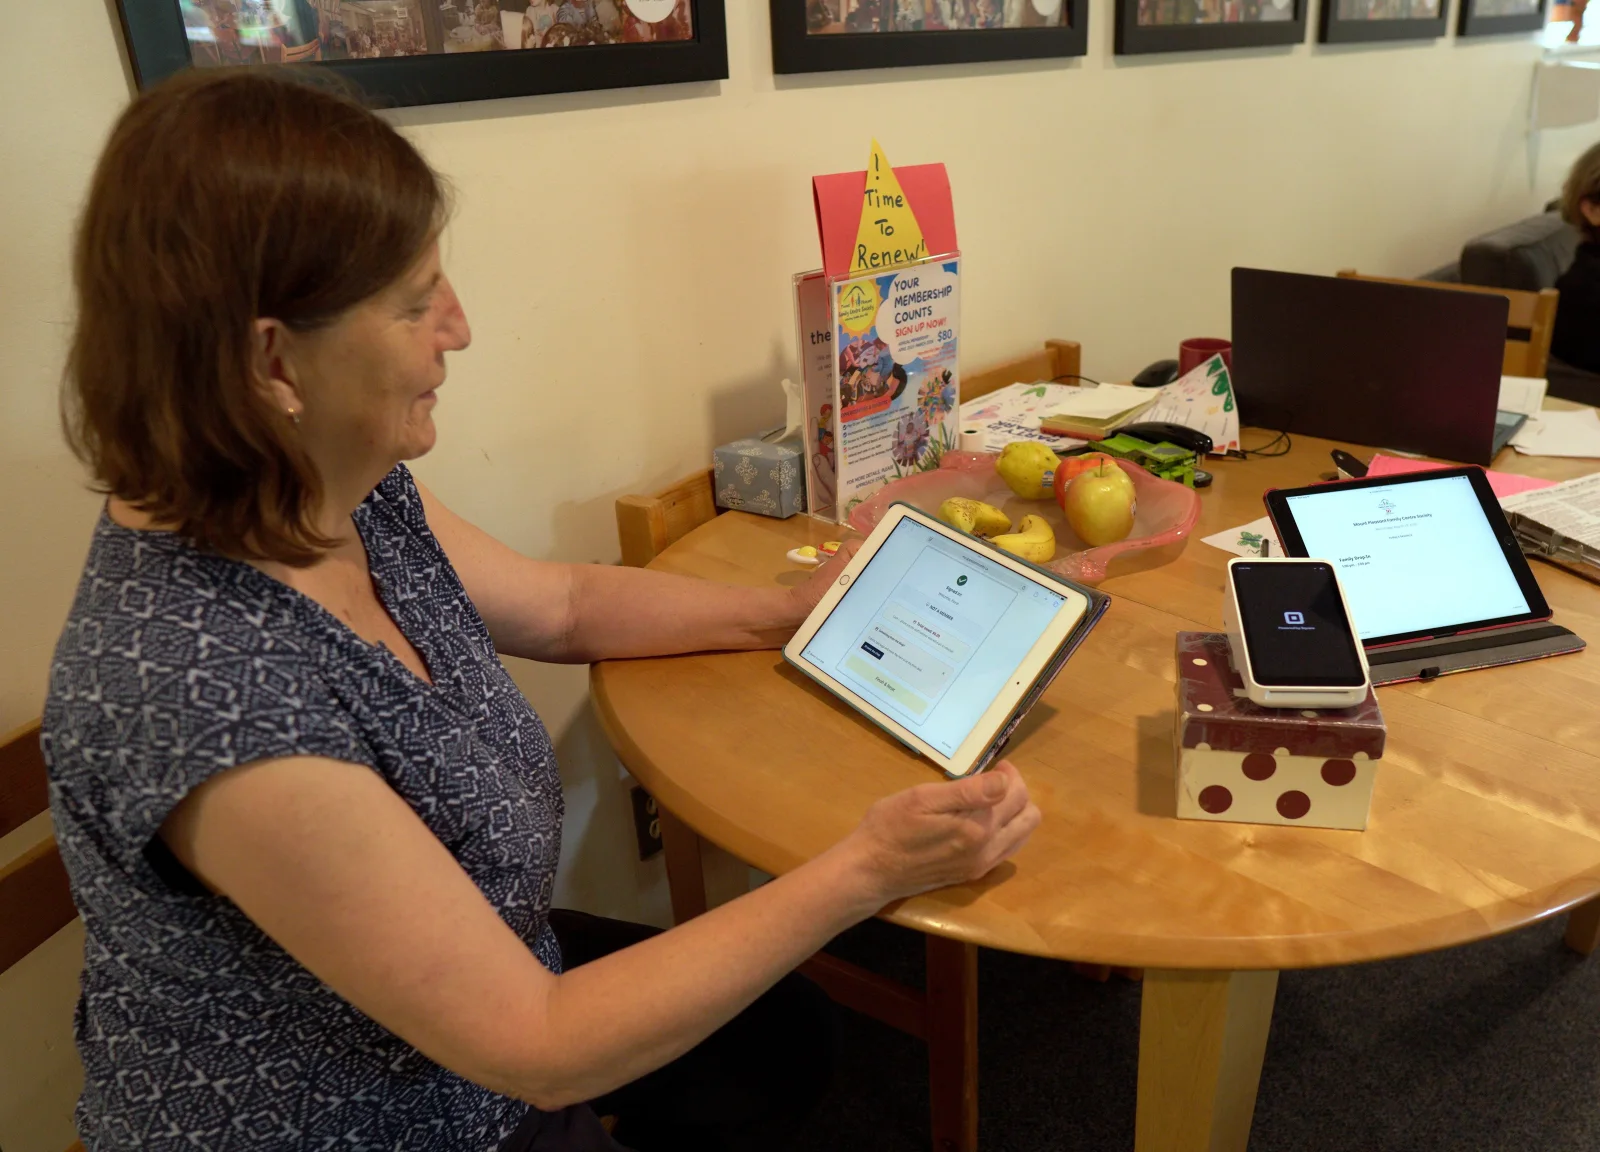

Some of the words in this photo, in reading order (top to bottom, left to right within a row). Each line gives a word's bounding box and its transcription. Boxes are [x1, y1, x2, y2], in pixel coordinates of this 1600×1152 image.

[864, 188, 904, 208] Time
[874, 218, 895, 236] To
[858, 238, 926, 269] Renew!
[894, 277, 920, 293] YOUR
[894, 285, 953, 308] MEMBERSHIP
[894, 306, 932, 325] COUNTS
[895, 325, 913, 338] SIGN
[914, 322, 925, 334] UP
[926, 316, 947, 331] NOW!
[937, 328, 953, 342] $80
[810, 330, 832, 346] the
[946, 586, 958, 595] Signed
